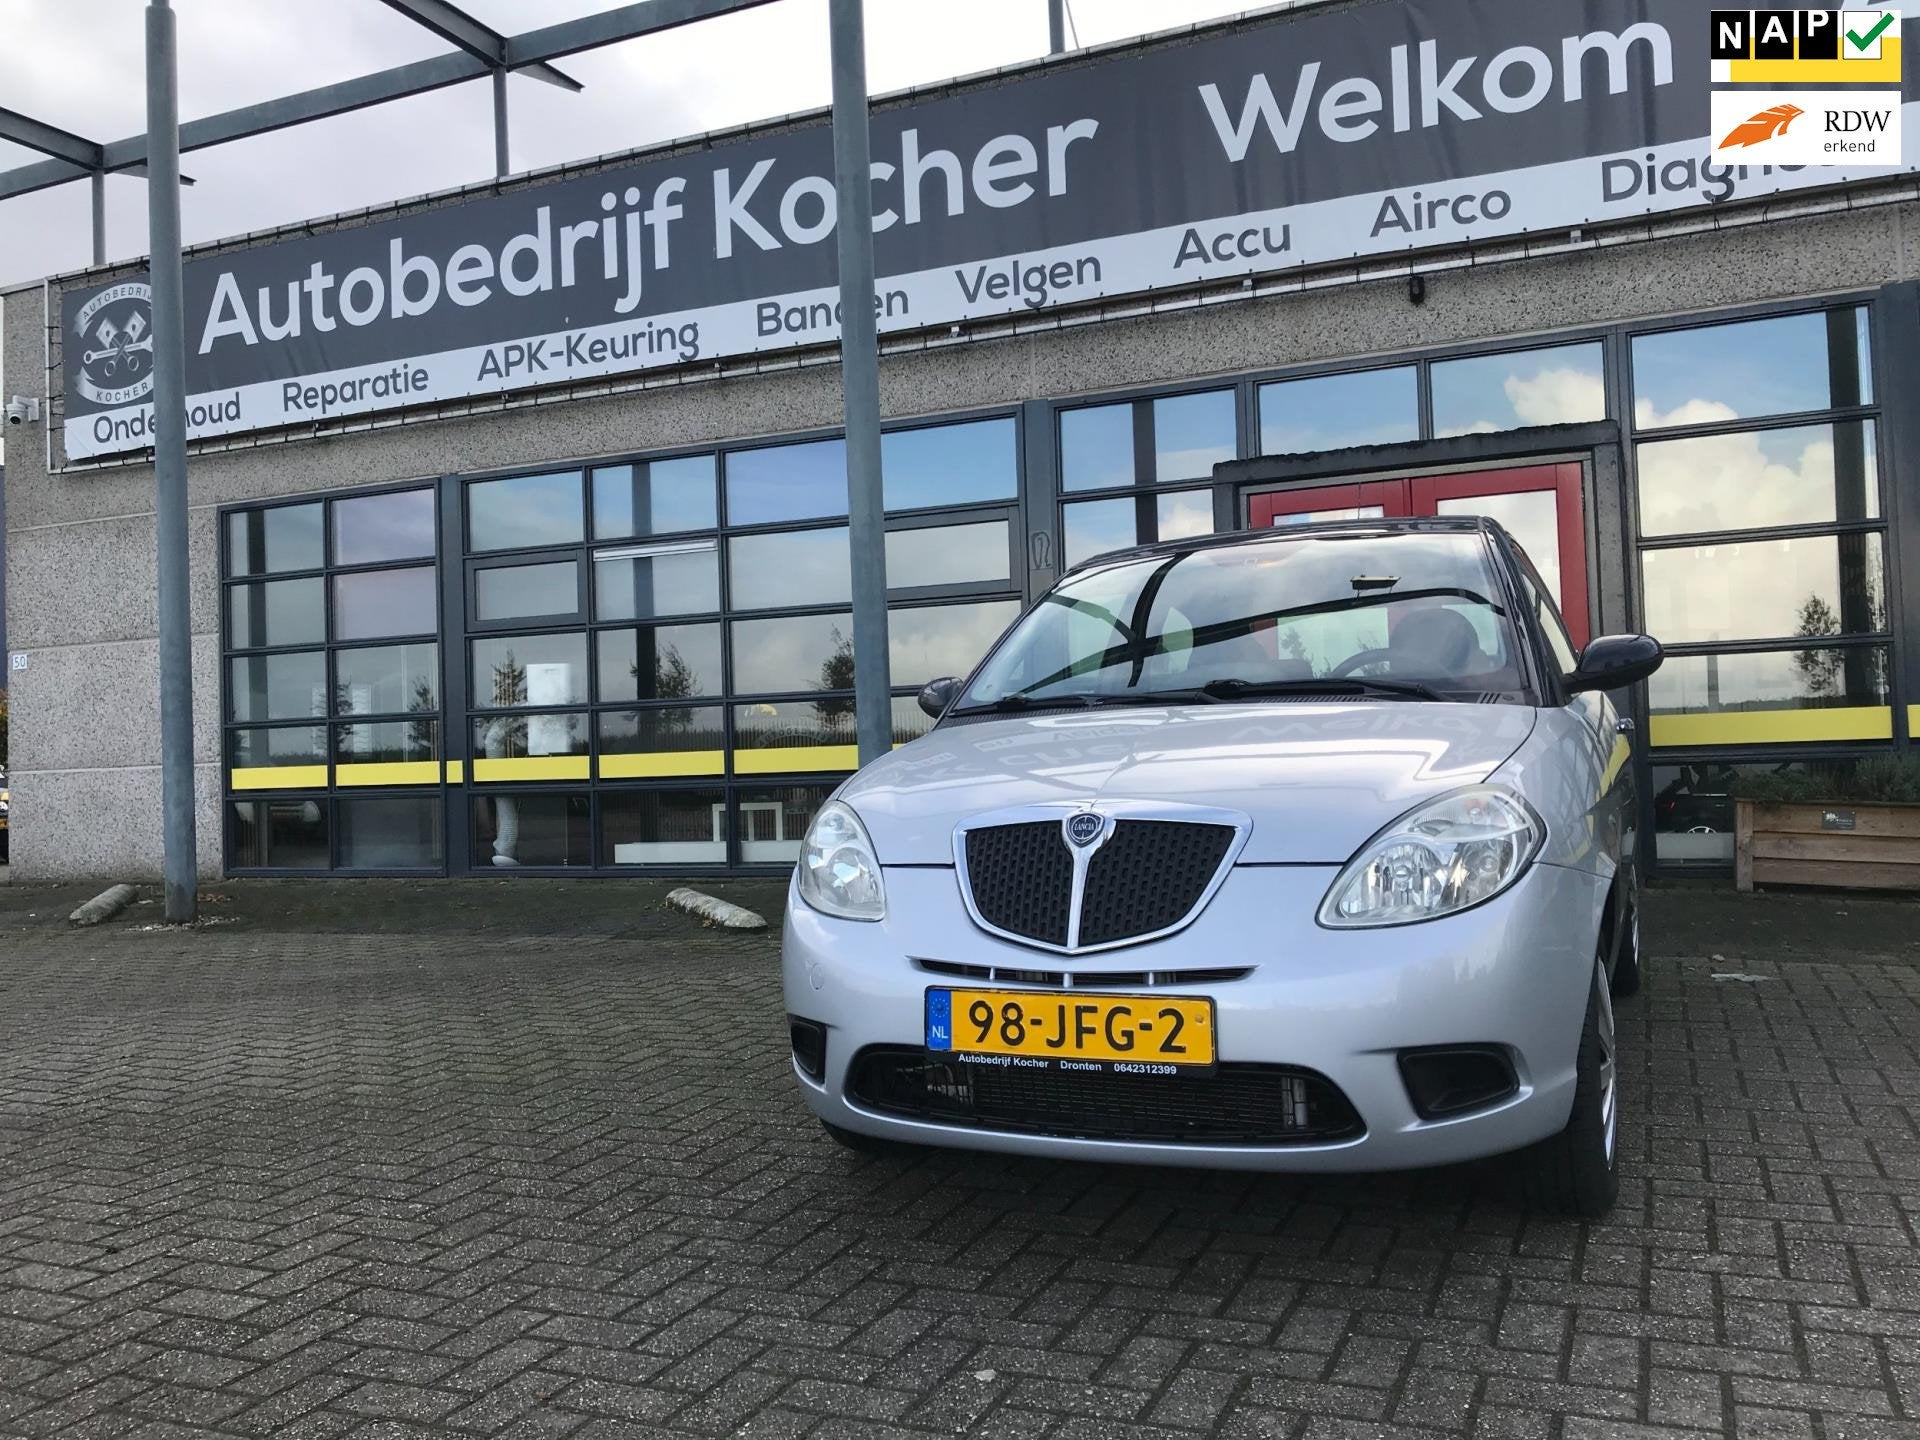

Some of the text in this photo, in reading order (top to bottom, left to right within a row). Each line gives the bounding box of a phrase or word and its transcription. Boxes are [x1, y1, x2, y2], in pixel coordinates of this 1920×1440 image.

[198, 176, 687, 356] Autobedrijf
[1198, 22, 1674, 163] Welkom
[83, 286, 152, 320] AUTOBEDRI
[282, 364, 430, 415] Reparatie
[477, 321, 700, 382] APK-Keuring
[954, 254, 1102, 309] Velgen
[1172, 219, 1292, 270] Accu
[1370, 190, 1512, 238] Airco
[96, 381, 149, 402] KOCHER
[14, 656, 26, 668] 50
[931, 1025, 949, 1039] NL
[968, 1000, 1187, 1053] 98-JFG-2
[958, 1053, 1177, 1075] Autobedrijf Kocher Dronten 0642312399
